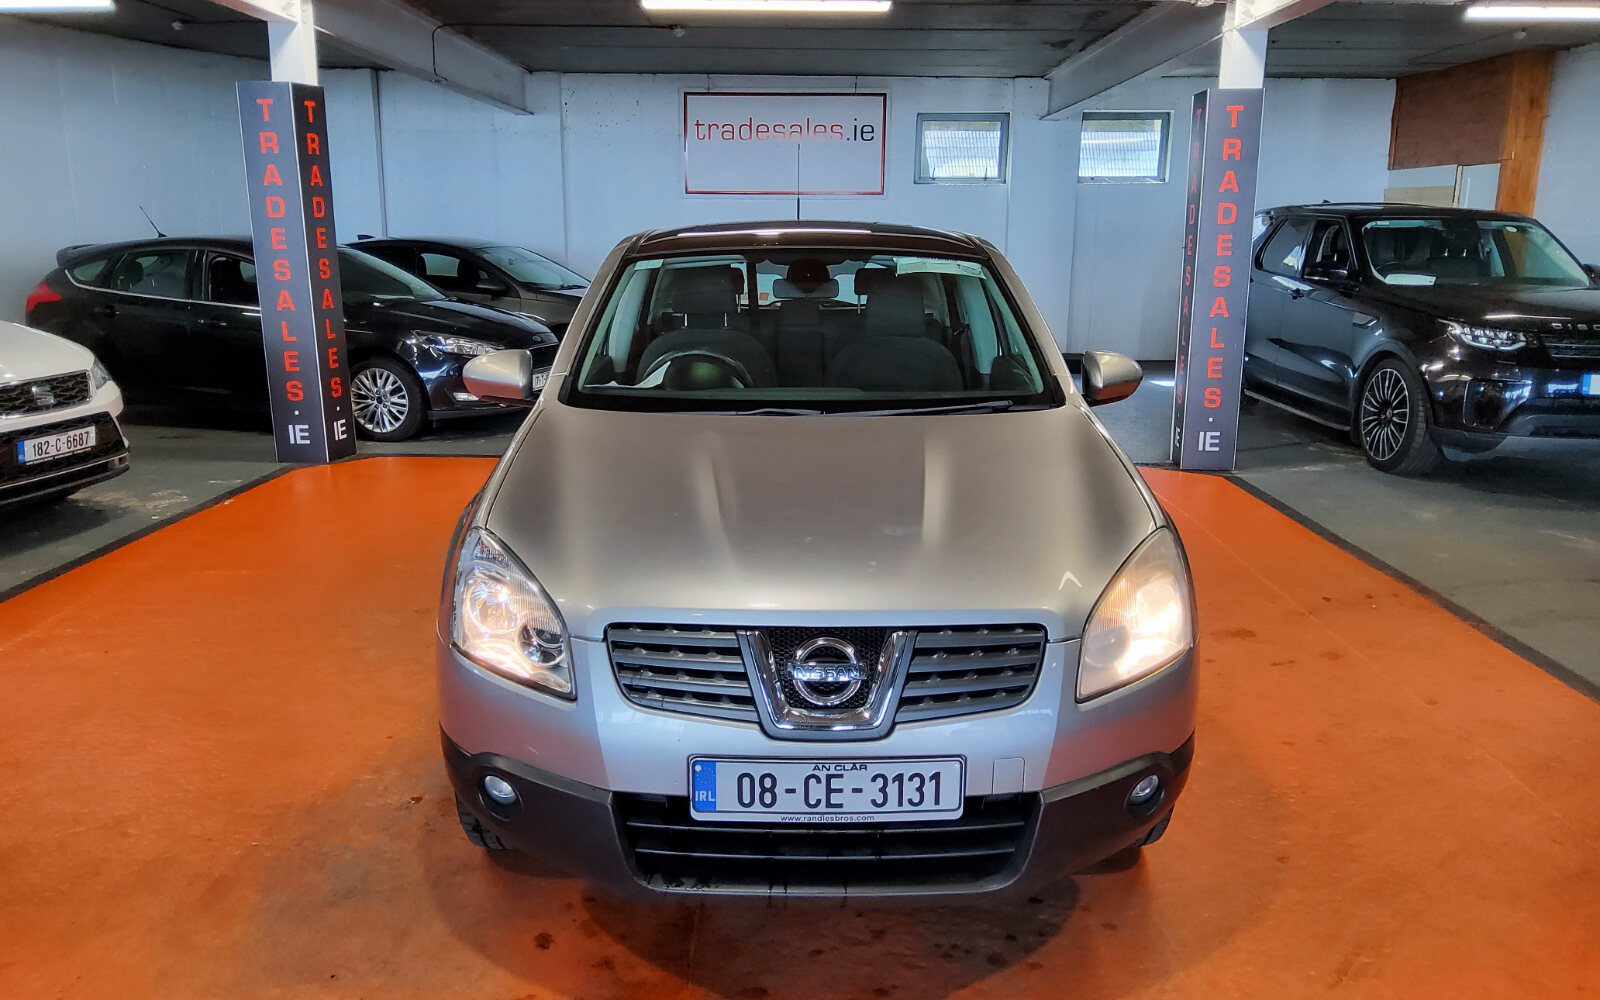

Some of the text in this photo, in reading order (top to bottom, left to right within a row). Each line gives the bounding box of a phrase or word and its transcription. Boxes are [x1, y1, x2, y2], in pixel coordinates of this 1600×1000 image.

[693, 116, 875, 142] tradesales.ie
[32, 430, 90, 458] 182-C-6687
[795, 666, 860, 679] NISSAN
[812, 764, 831, 772] AN
[694, 790, 716, 802] IRL
[736, 771, 941, 809] 08-CE-3131
[780, 814, 875, 822] www.randlesbros.com
